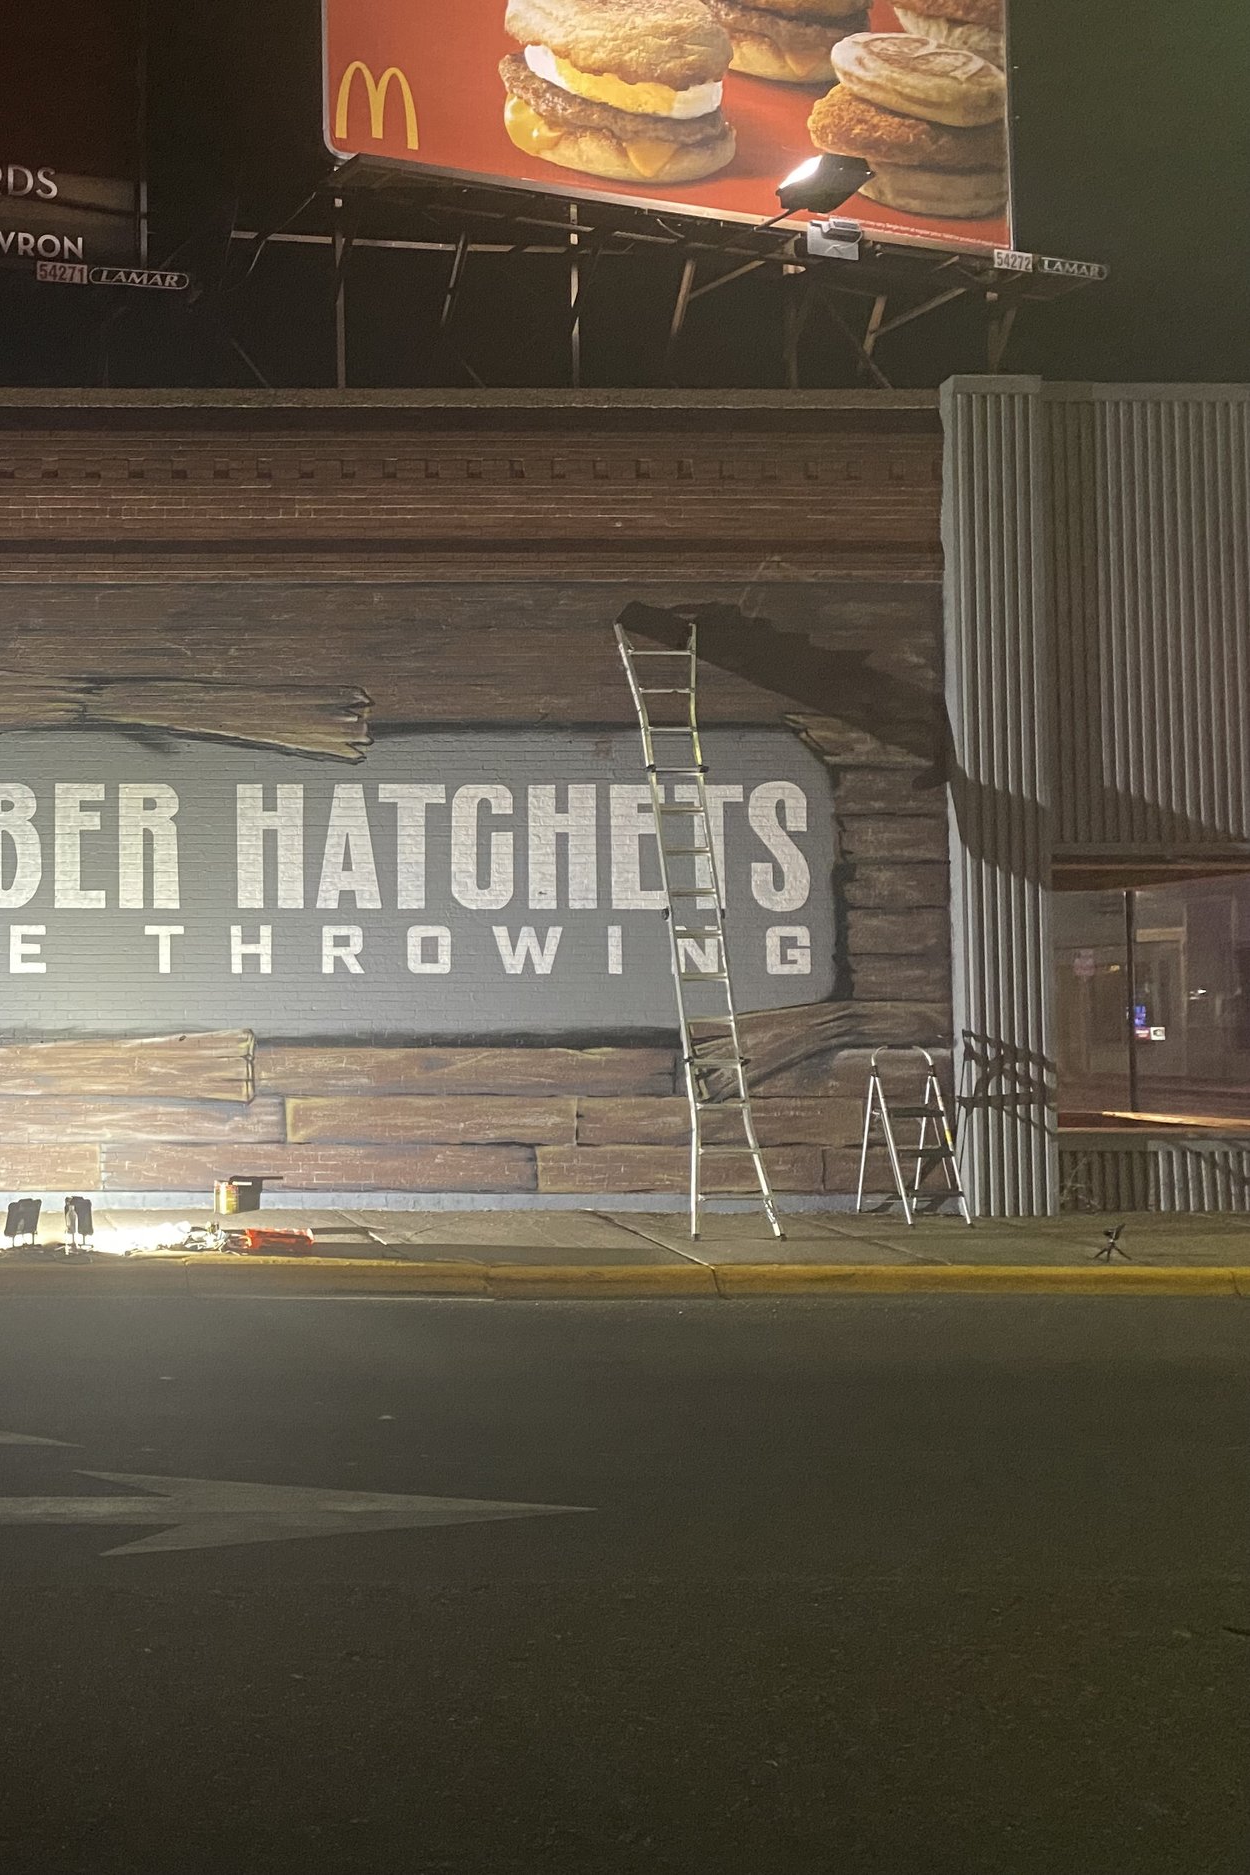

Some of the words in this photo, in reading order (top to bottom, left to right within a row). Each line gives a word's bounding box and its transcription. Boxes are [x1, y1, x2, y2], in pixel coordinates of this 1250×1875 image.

[996, 251, 1032, 271] 54272
[1043, 258, 1101, 278] LAMAR
[39, 263, 85, 283] 54271
[100, 269, 179, 287] LAMAR
[236, 781, 811, 912] HATCHETS
[144, 925, 812, 975] THROWING
